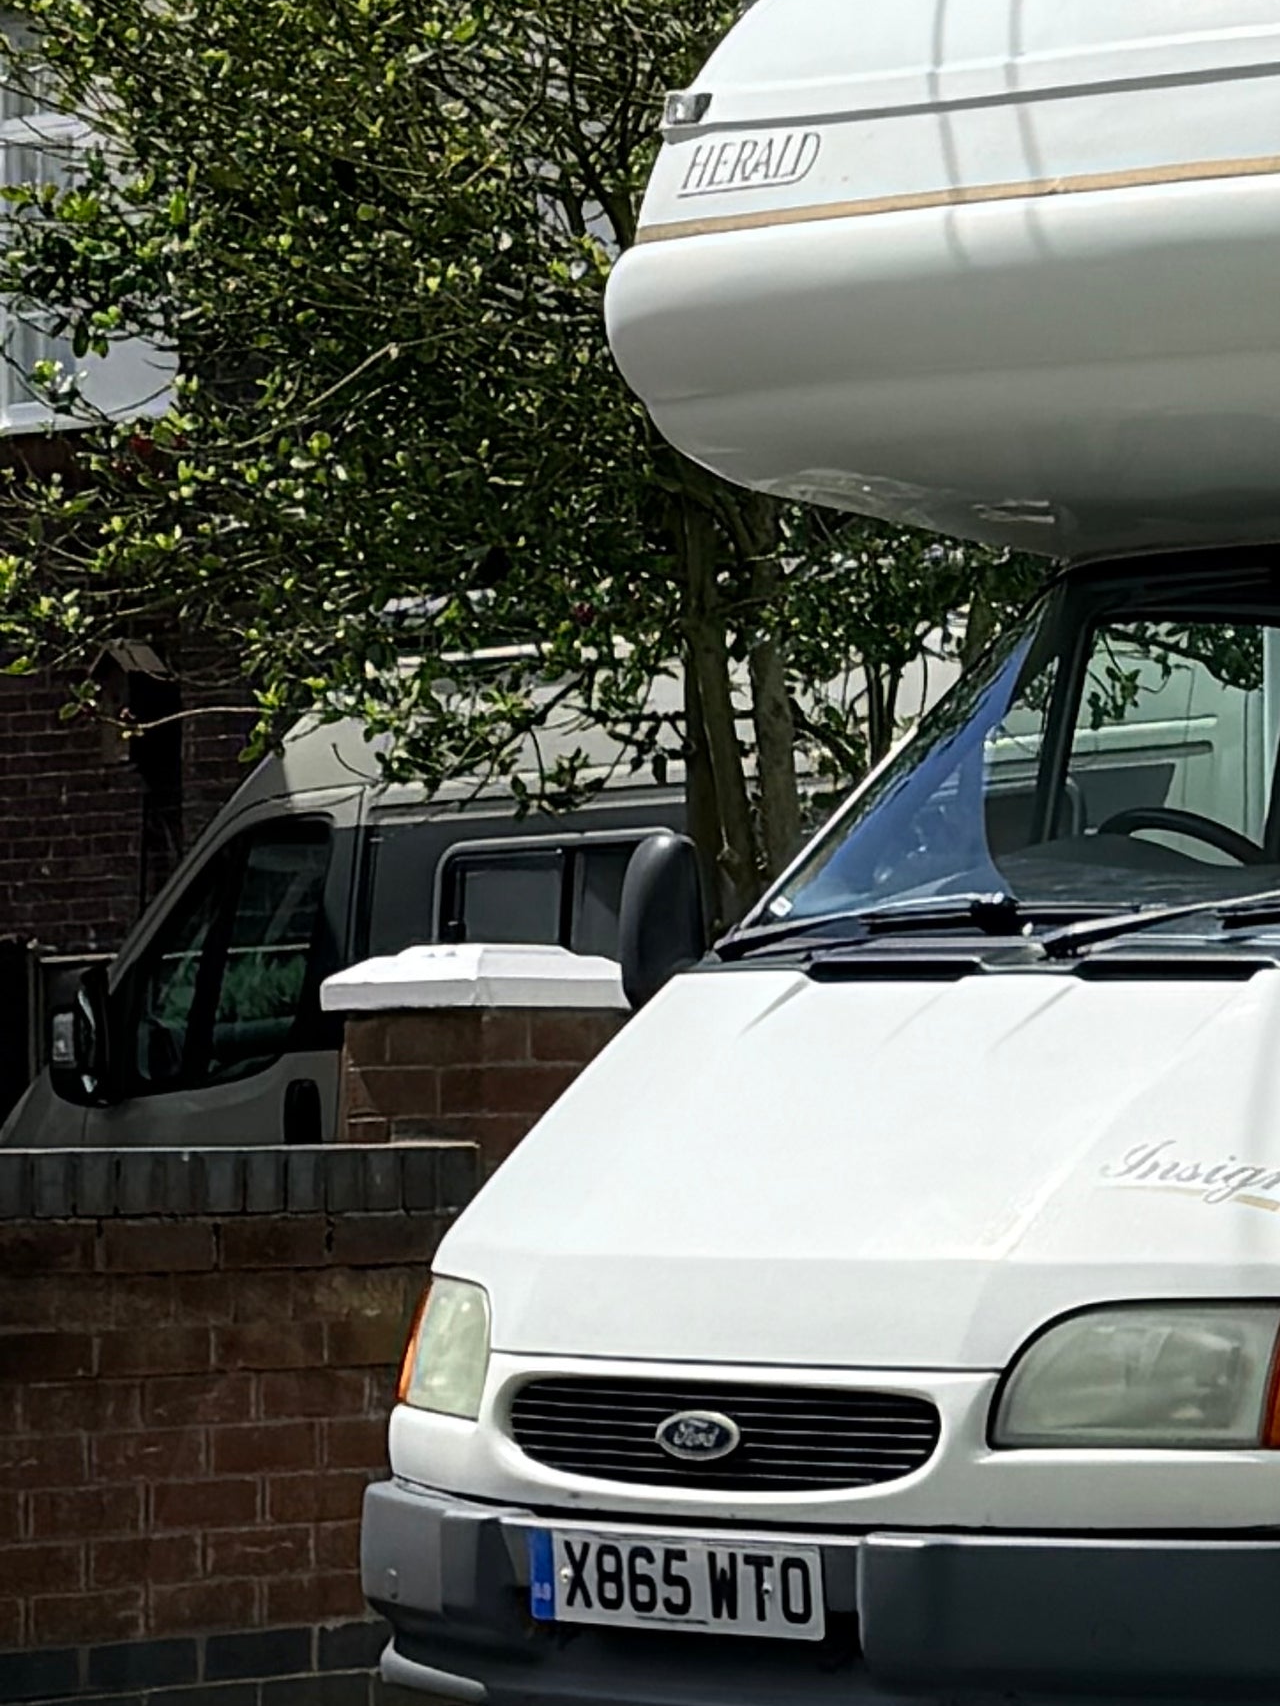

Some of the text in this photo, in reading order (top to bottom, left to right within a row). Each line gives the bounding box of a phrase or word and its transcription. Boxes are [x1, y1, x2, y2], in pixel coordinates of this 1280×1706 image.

[679, 131, 821, 193] HERALD
[673, 1418, 720, 1448] Ford
[563, 1539, 814, 1625] X865 WTO
